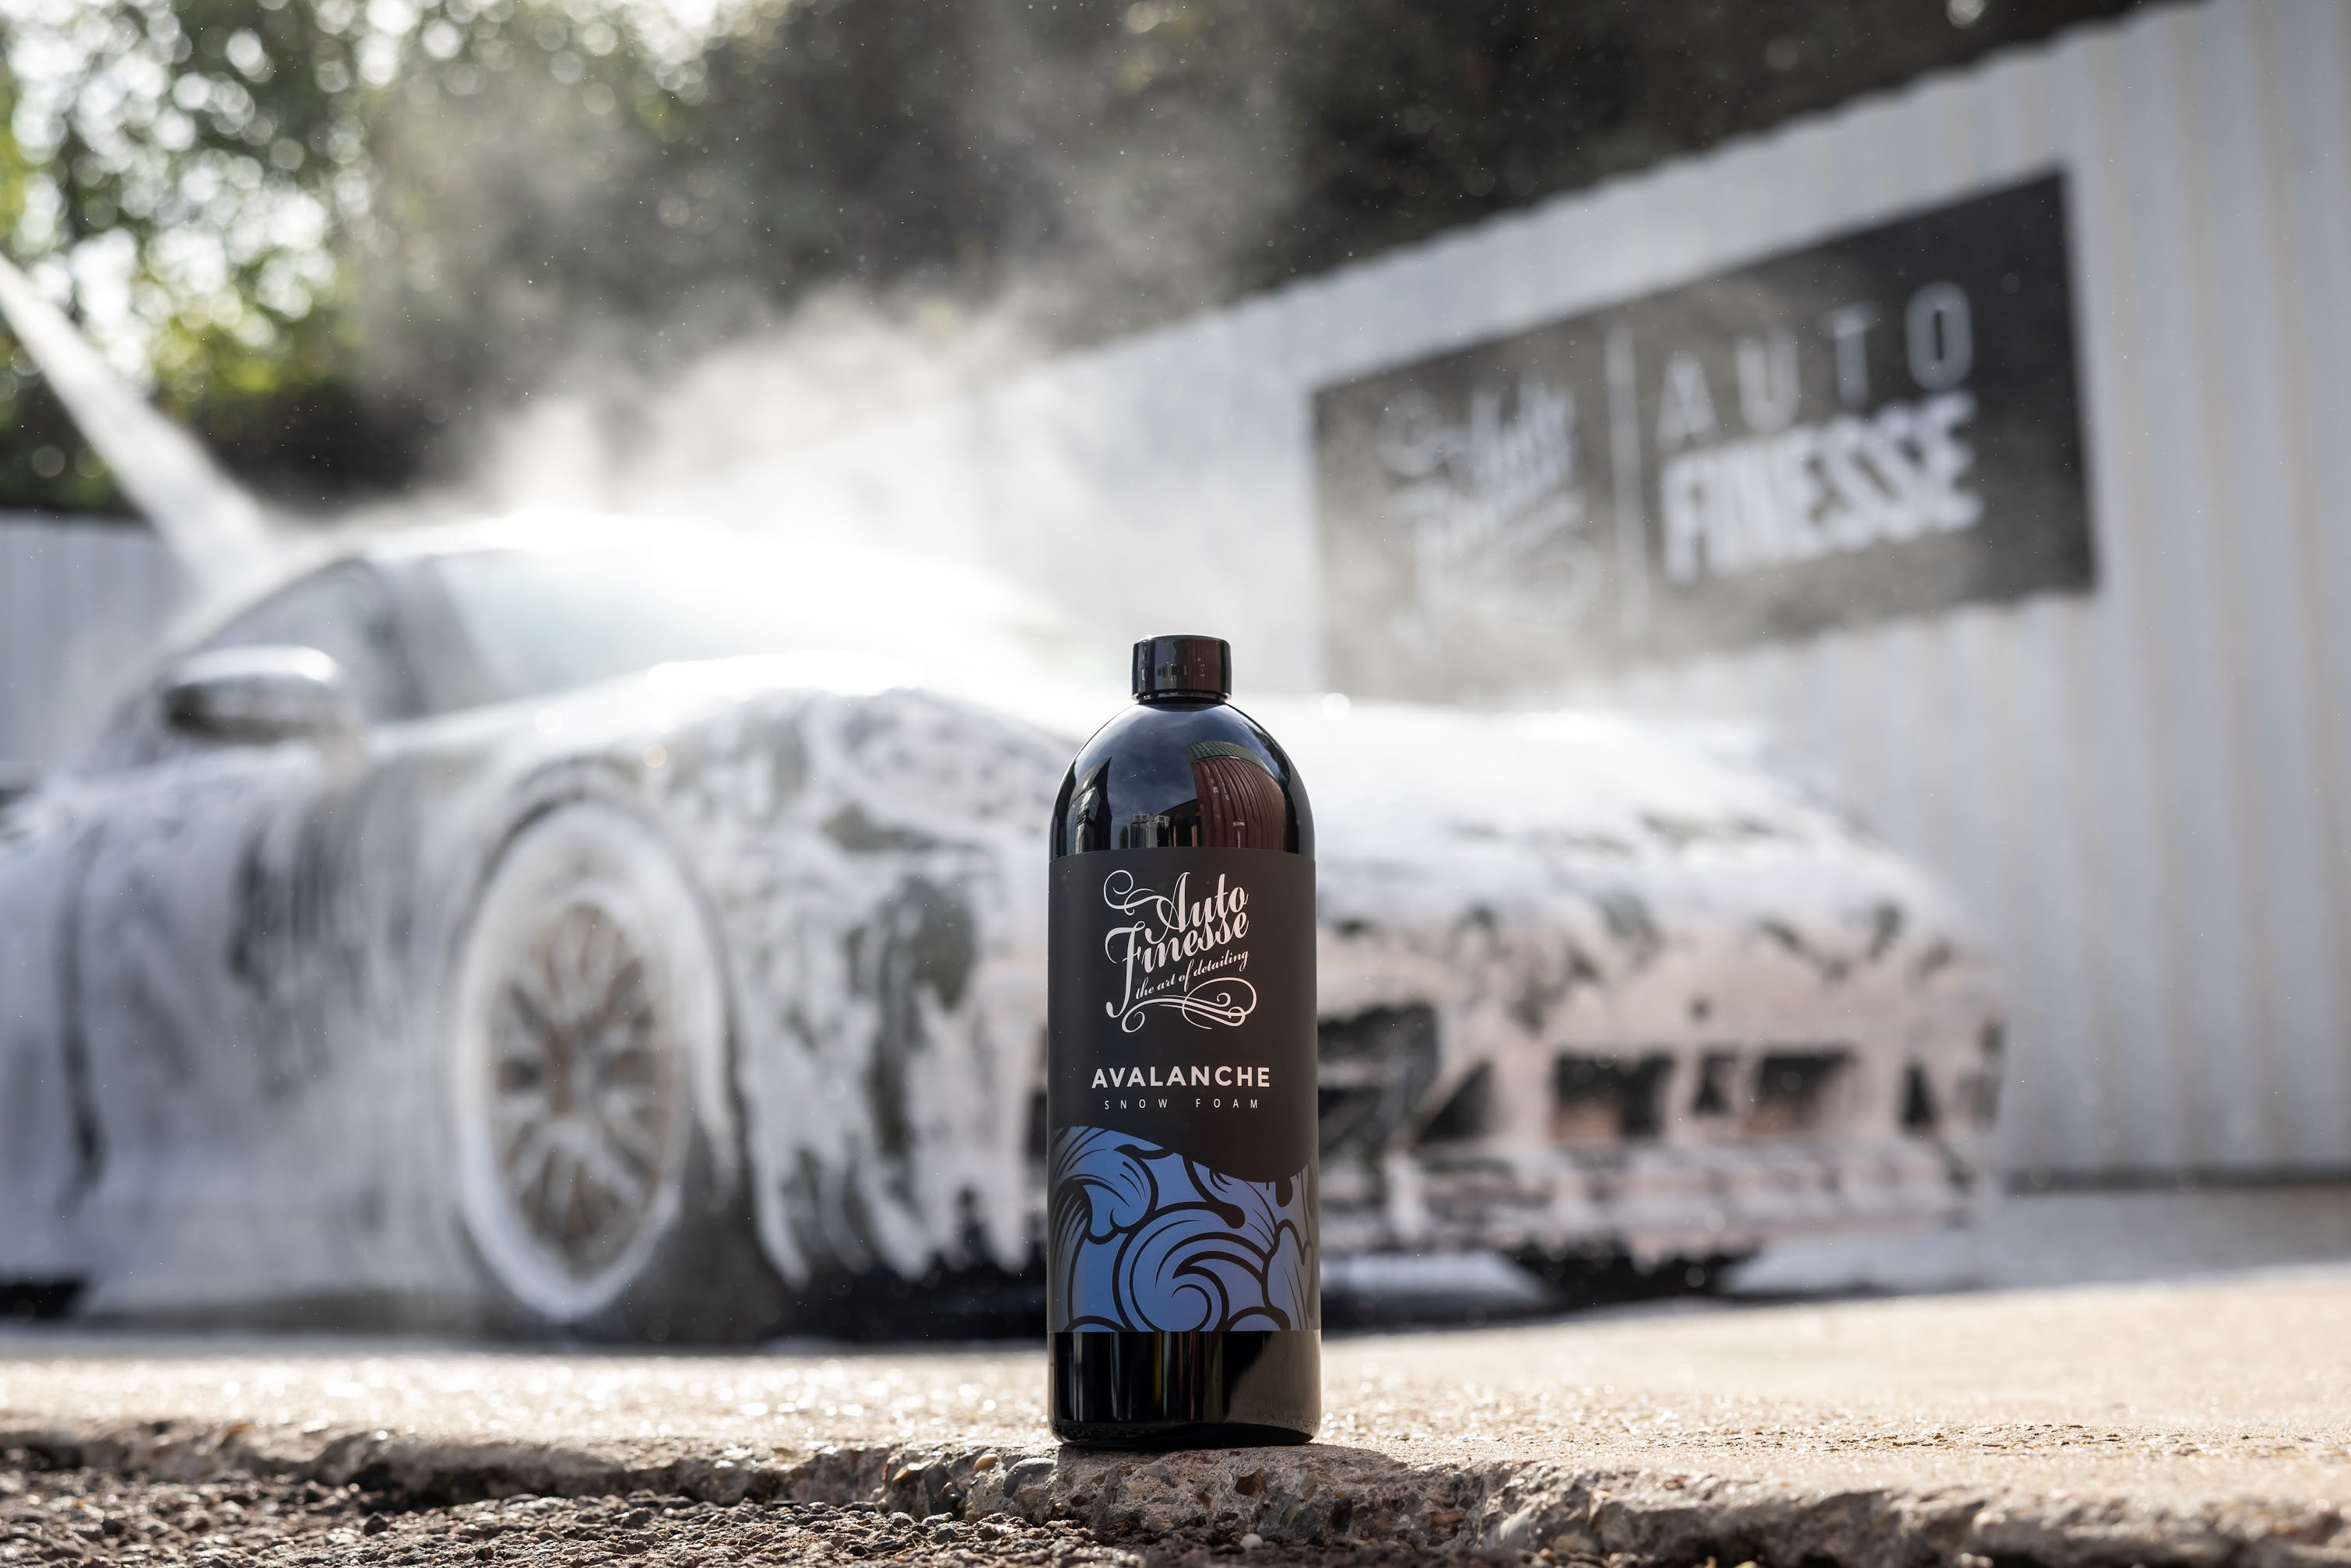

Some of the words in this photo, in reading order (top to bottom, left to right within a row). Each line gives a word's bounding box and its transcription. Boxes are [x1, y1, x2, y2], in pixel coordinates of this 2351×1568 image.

[1657, 281, 1975, 453] AUTO
[1104, 870, 1249, 944] Auto
[1105, 912, 1249, 1018] Finesse
[1135, 977, 1154, 1000] the
[1157, 973, 1176, 991] art
[1178, 958, 1195, 992] of
[1193, 949, 1249, 976] detailing
[1091, 1066, 1270, 1088] AVALANCHE
[1104, 1099, 1168, 1109] SNOW
[1196, 1098, 1258, 1109] FOAM
